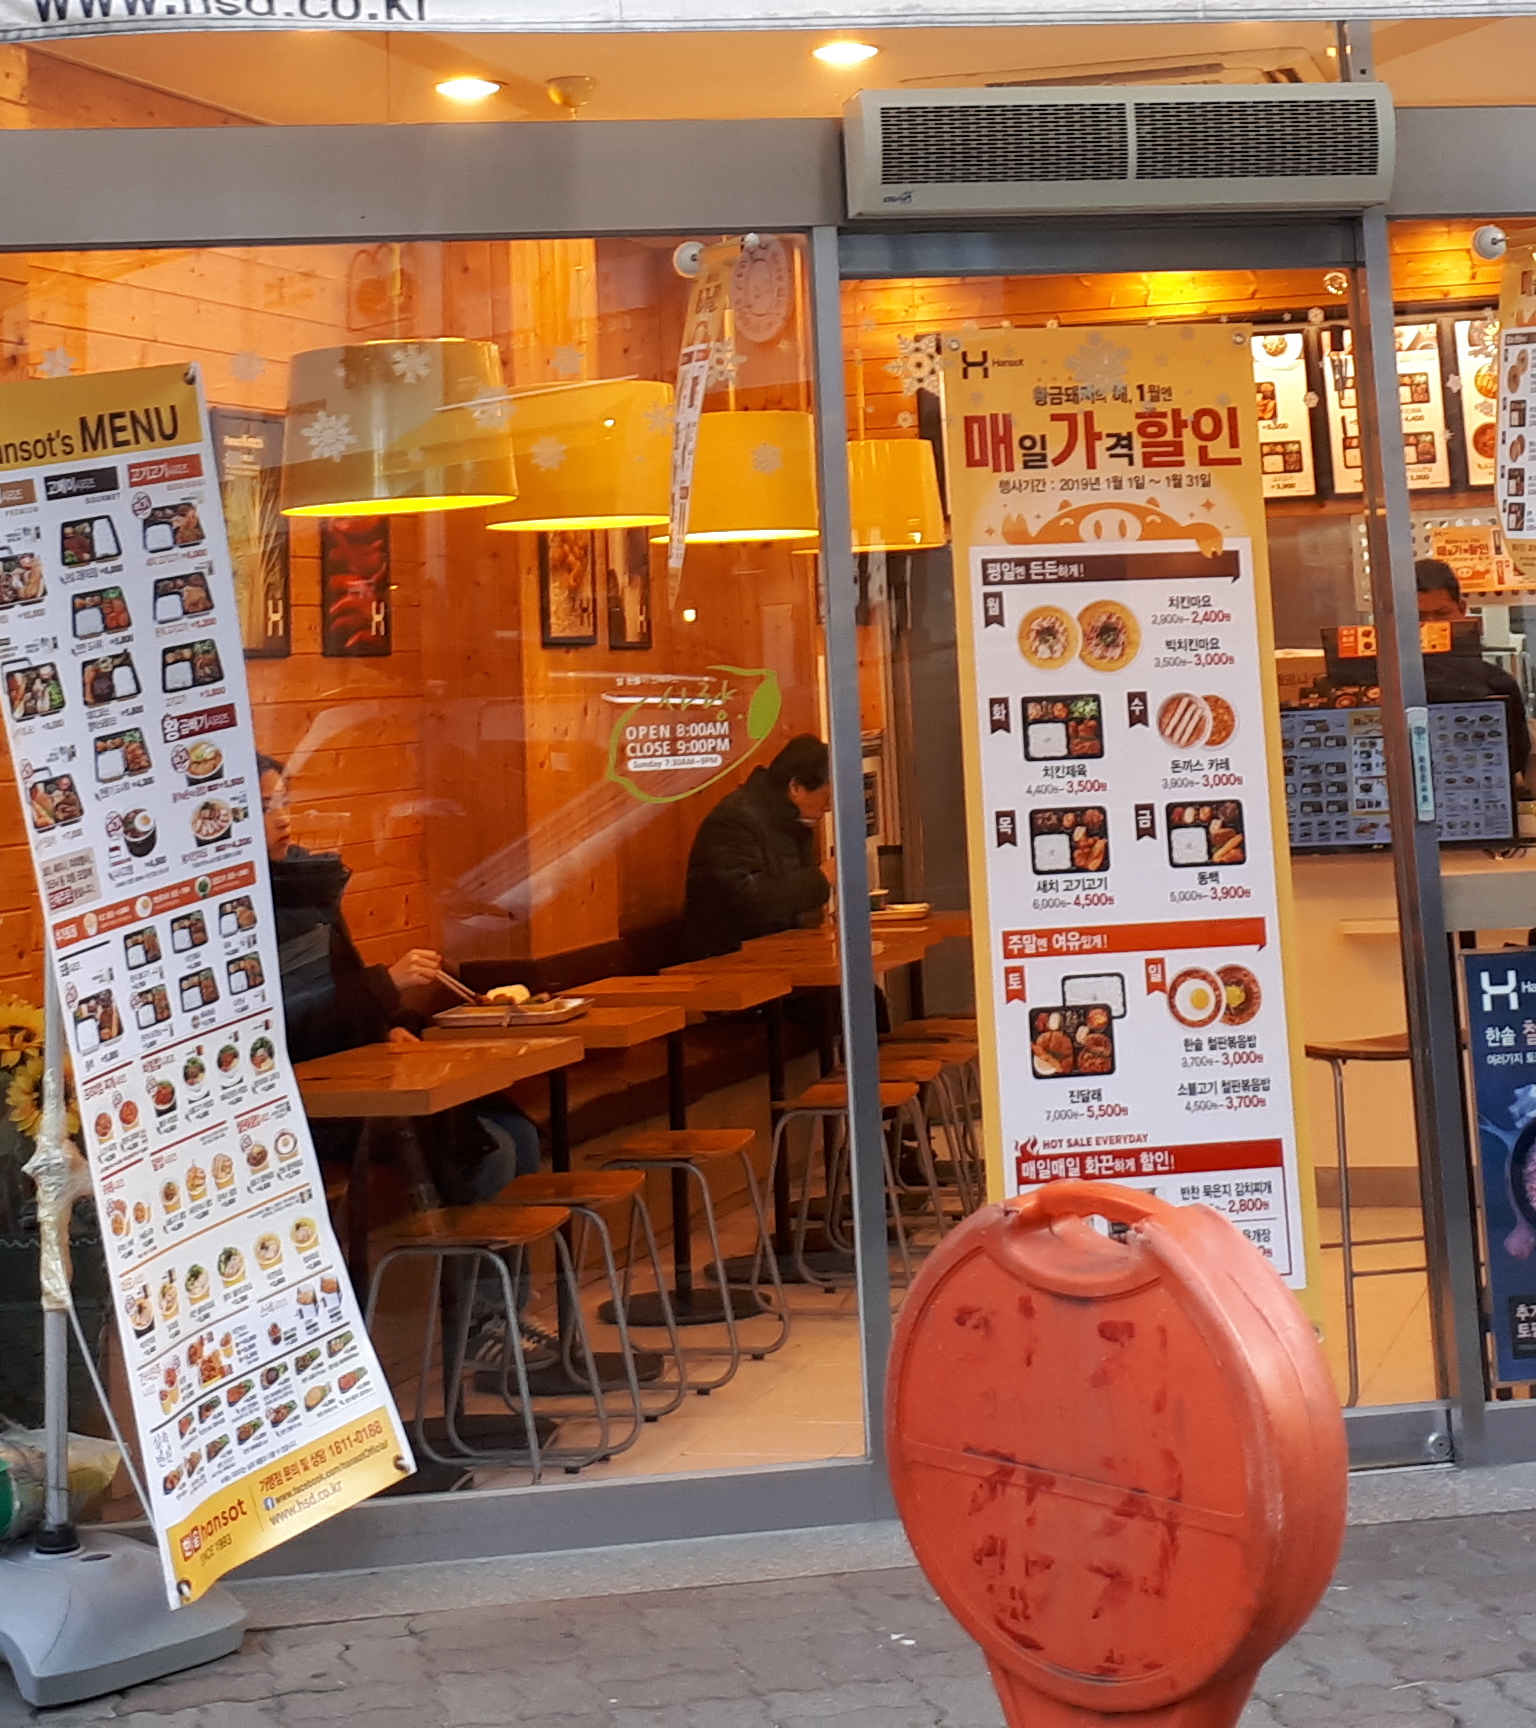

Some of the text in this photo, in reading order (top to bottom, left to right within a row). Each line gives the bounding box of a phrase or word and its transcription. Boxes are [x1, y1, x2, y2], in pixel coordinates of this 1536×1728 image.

[78, 403, 180, 453] MENU
[963, 406, 1243, 473] 매일가격할인
[1059, 476, 1101, 492] 2019년
[1105, 475, 1124, 490] 1월
[1185, 472, 1212, 489] 31일
[1168, 594, 1213, 610] 치킨마요
[625, 721, 730, 740] OPEN 8:00AM
[626, 738, 731, 757] CLOSE 9:00PM
[1169, 758, 1205, 774] 돈까스
[1062, 876, 1109, 892] 고기고기
[1042, 1132, 1149, 1150] HOT SALE EVERYDAY
[1021, 1156, 1081, 1180] 매일매일
